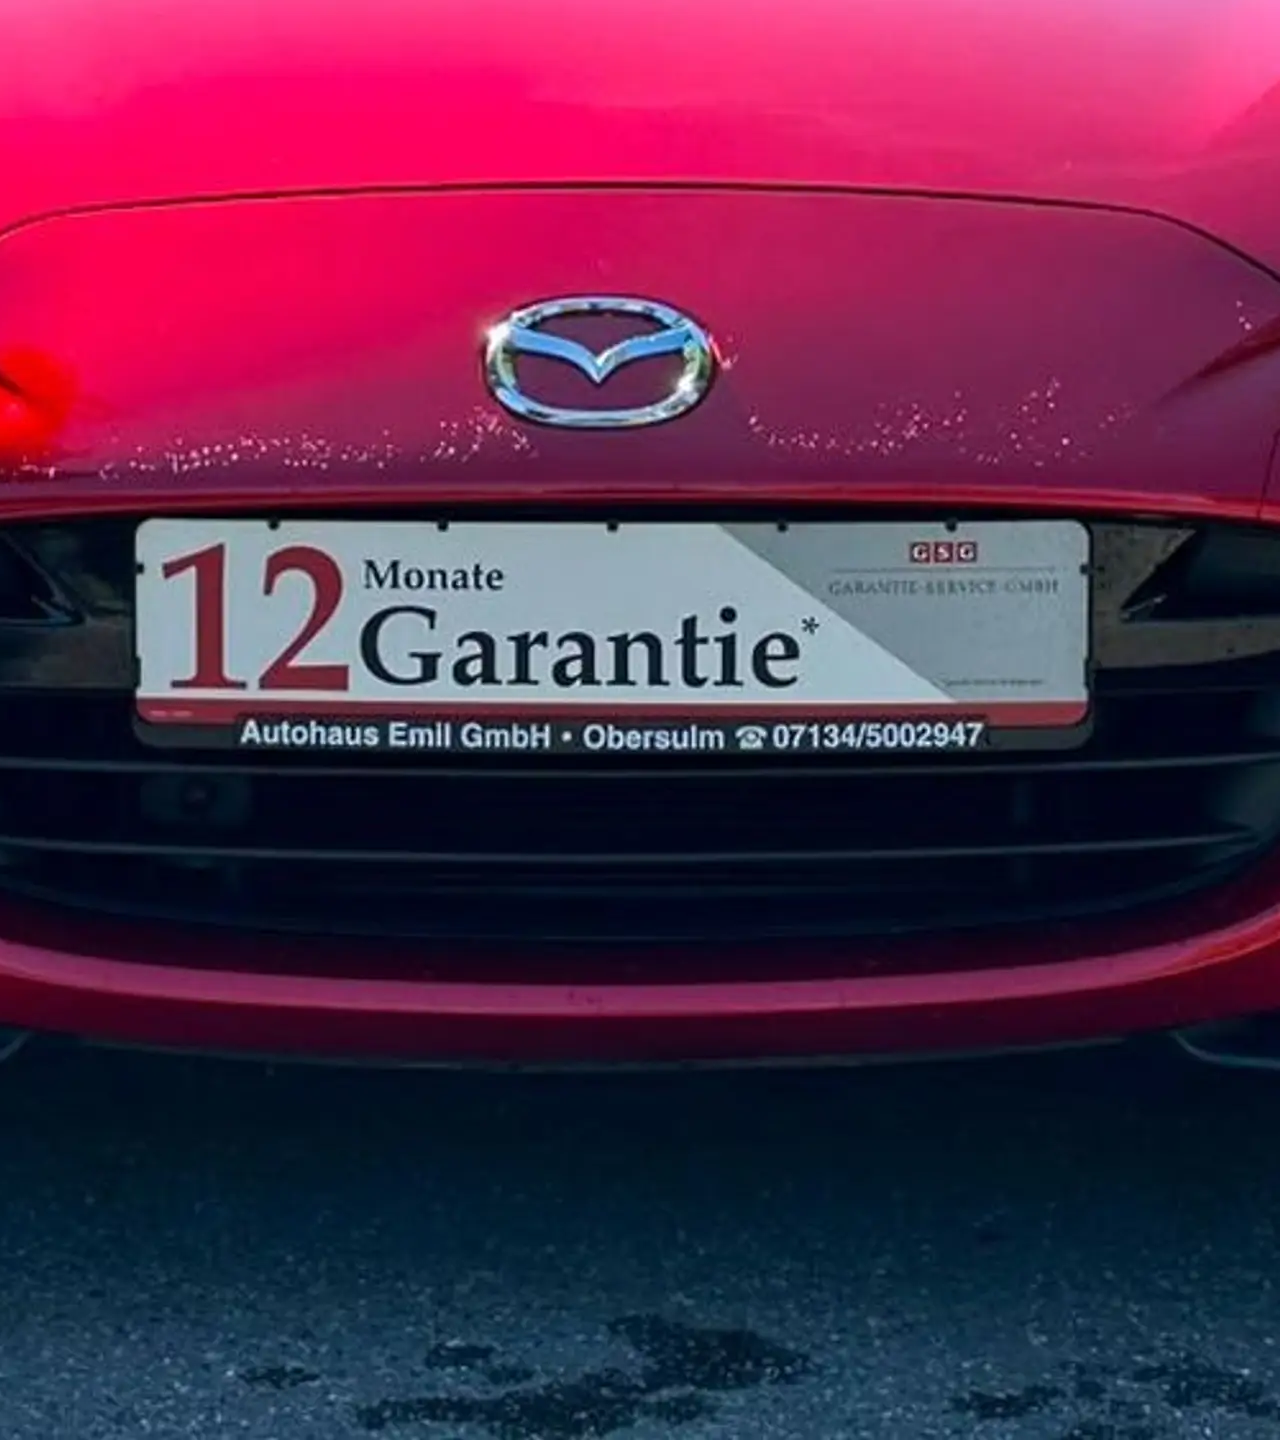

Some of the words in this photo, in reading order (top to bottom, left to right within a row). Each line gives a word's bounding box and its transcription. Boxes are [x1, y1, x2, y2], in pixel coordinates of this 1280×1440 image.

[910, 542, 977, 563] GSG
[162, 542, 350, 692] 12
[363, 560, 505, 592] Monate
[240, 718, 379, 748] Autohaus
[389, 721, 451, 748] Emil
[460, 723, 552, 750] GmbH
[582, 723, 726, 751] Obersulm
[772, 721, 985, 749] 07134/5002947
